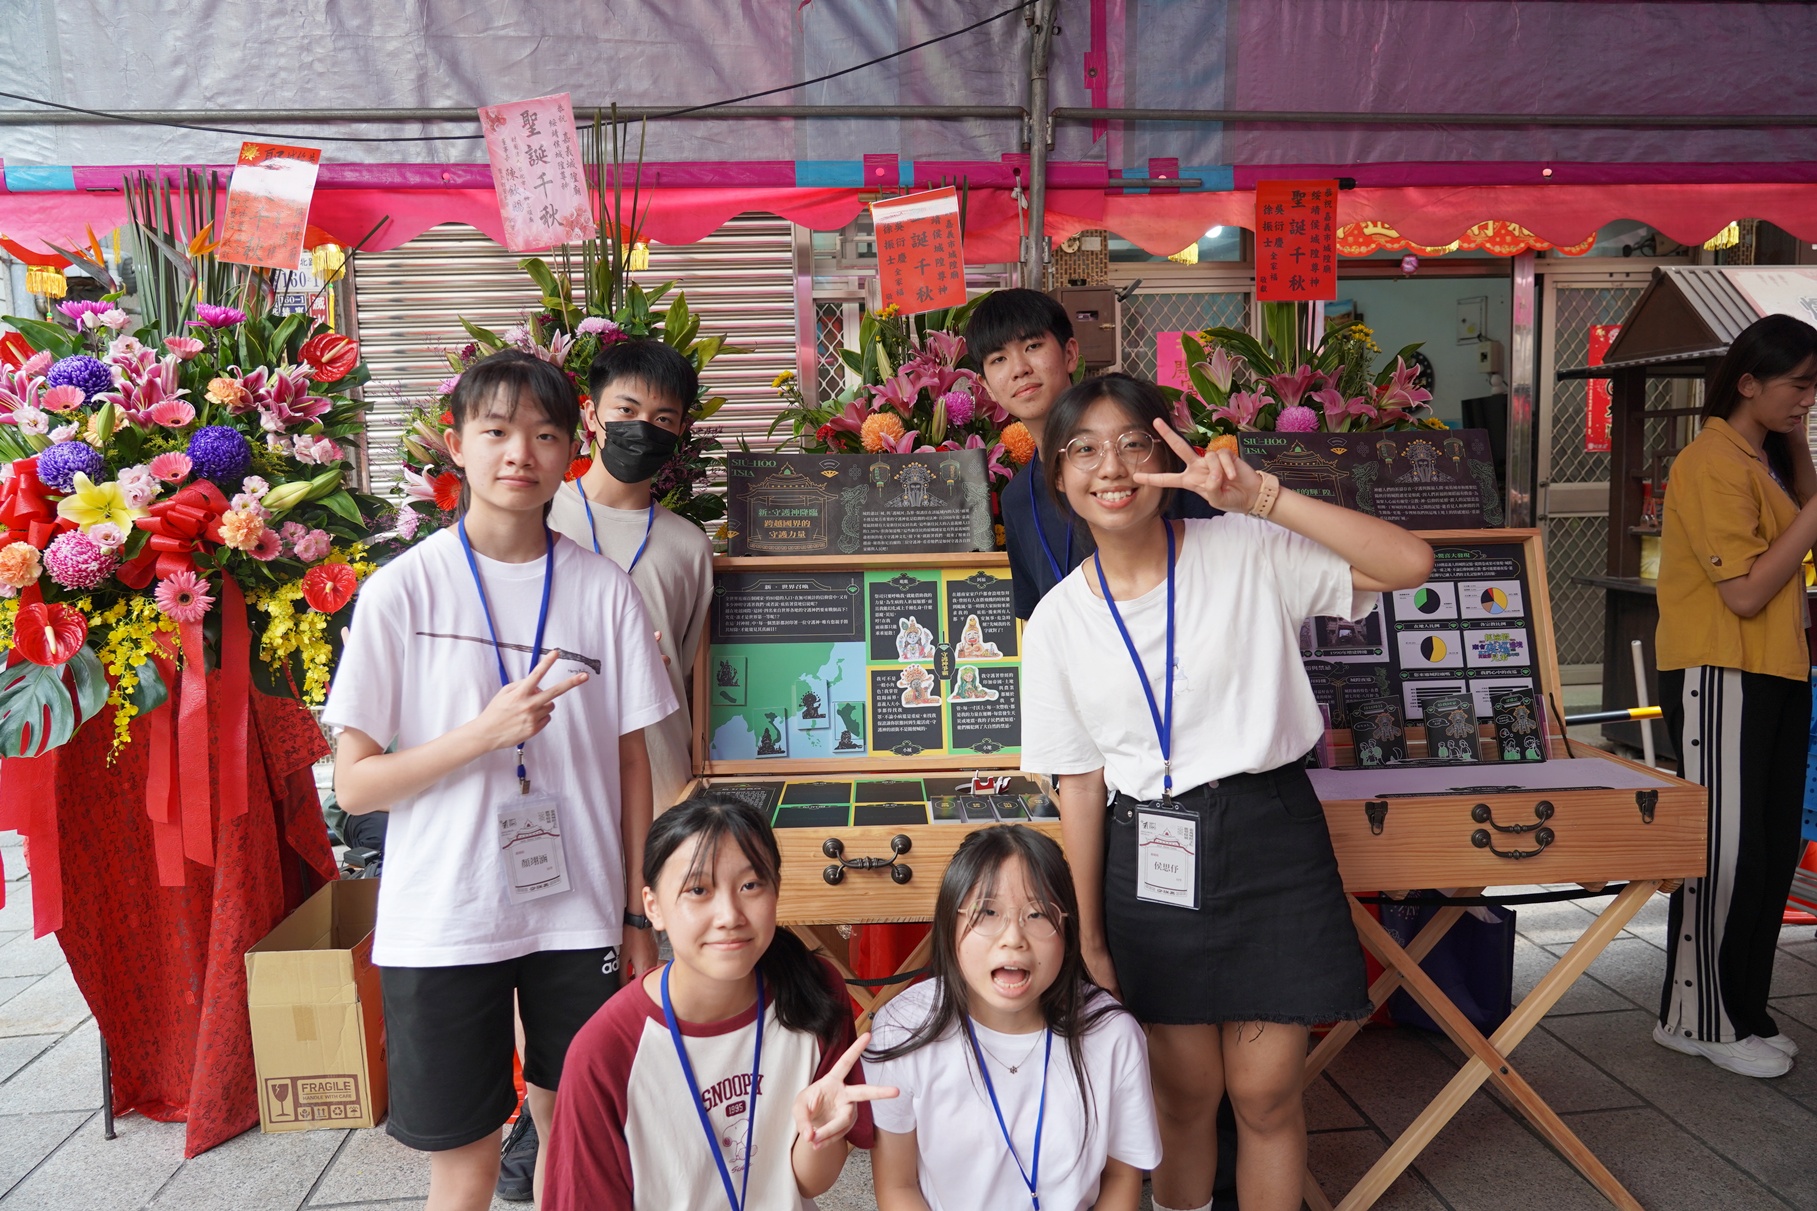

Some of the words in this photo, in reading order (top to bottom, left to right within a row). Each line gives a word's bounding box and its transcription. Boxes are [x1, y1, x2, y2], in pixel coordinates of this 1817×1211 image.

[520, 110, 564, 229] 聖誕千秋
[908, 217, 935, 303] 誕千秋
[945, 220, 959, 279] 嘉義市城隍廟
[1270, 252, 1278, 281] 全家福
[1288, 190, 1306, 291] 聖誕千秋
[1309, 191, 1321, 287] 綏靖侯城隍尊神
[1323, 212, 1332, 273] 嘉義市城隍廟
[895, 268, 904, 296] 全家福
[764, 519, 811, 528] 跨越國界的
[768, 530, 806, 539] 守護力量
[301, 1081, 351, 1093] FRAGILE
